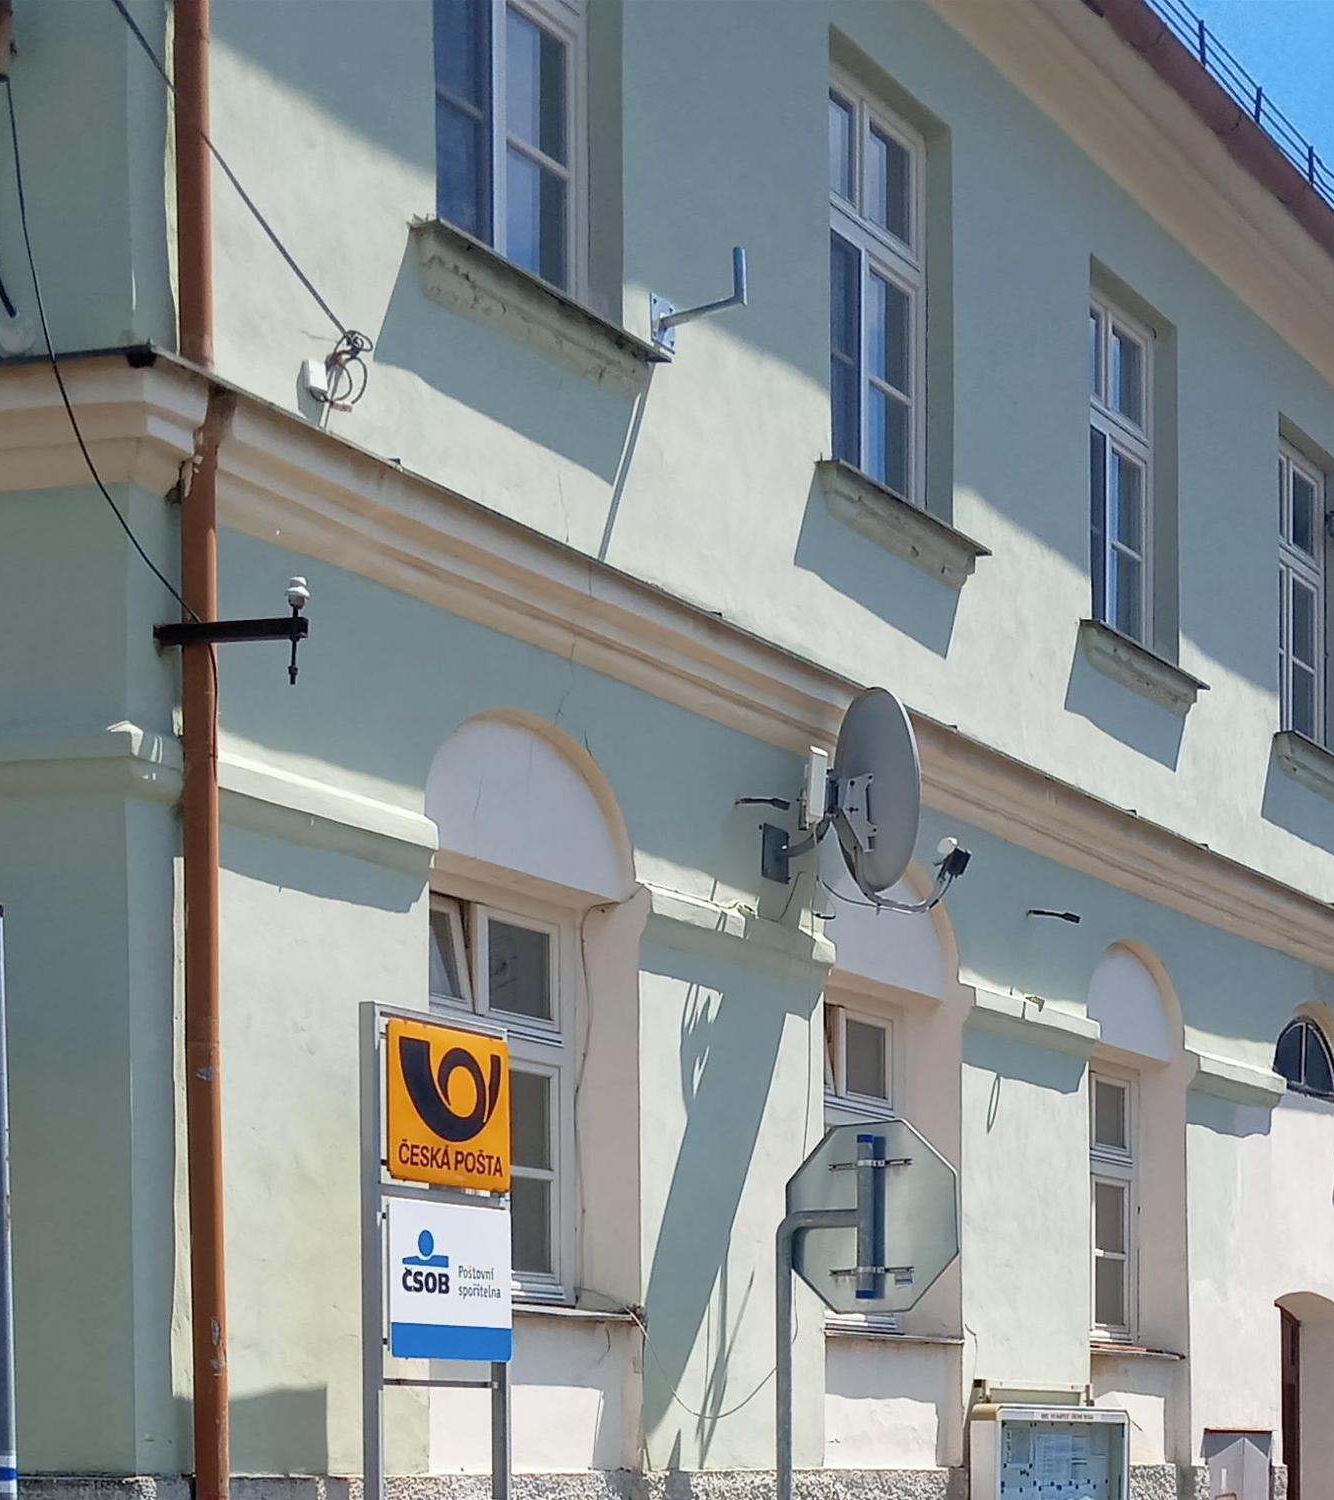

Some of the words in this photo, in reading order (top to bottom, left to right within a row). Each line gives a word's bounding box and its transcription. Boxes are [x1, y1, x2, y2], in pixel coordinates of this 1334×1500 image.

[398, 1139, 451, 1171] ČESKÁ
[454, 1150, 503, 1177] POŠTA
[402, 1267, 450, 1294] ČSOB
[458, 1265, 494, 1281] Poštovní
[458, 1283, 501, 1300] spořitelna
